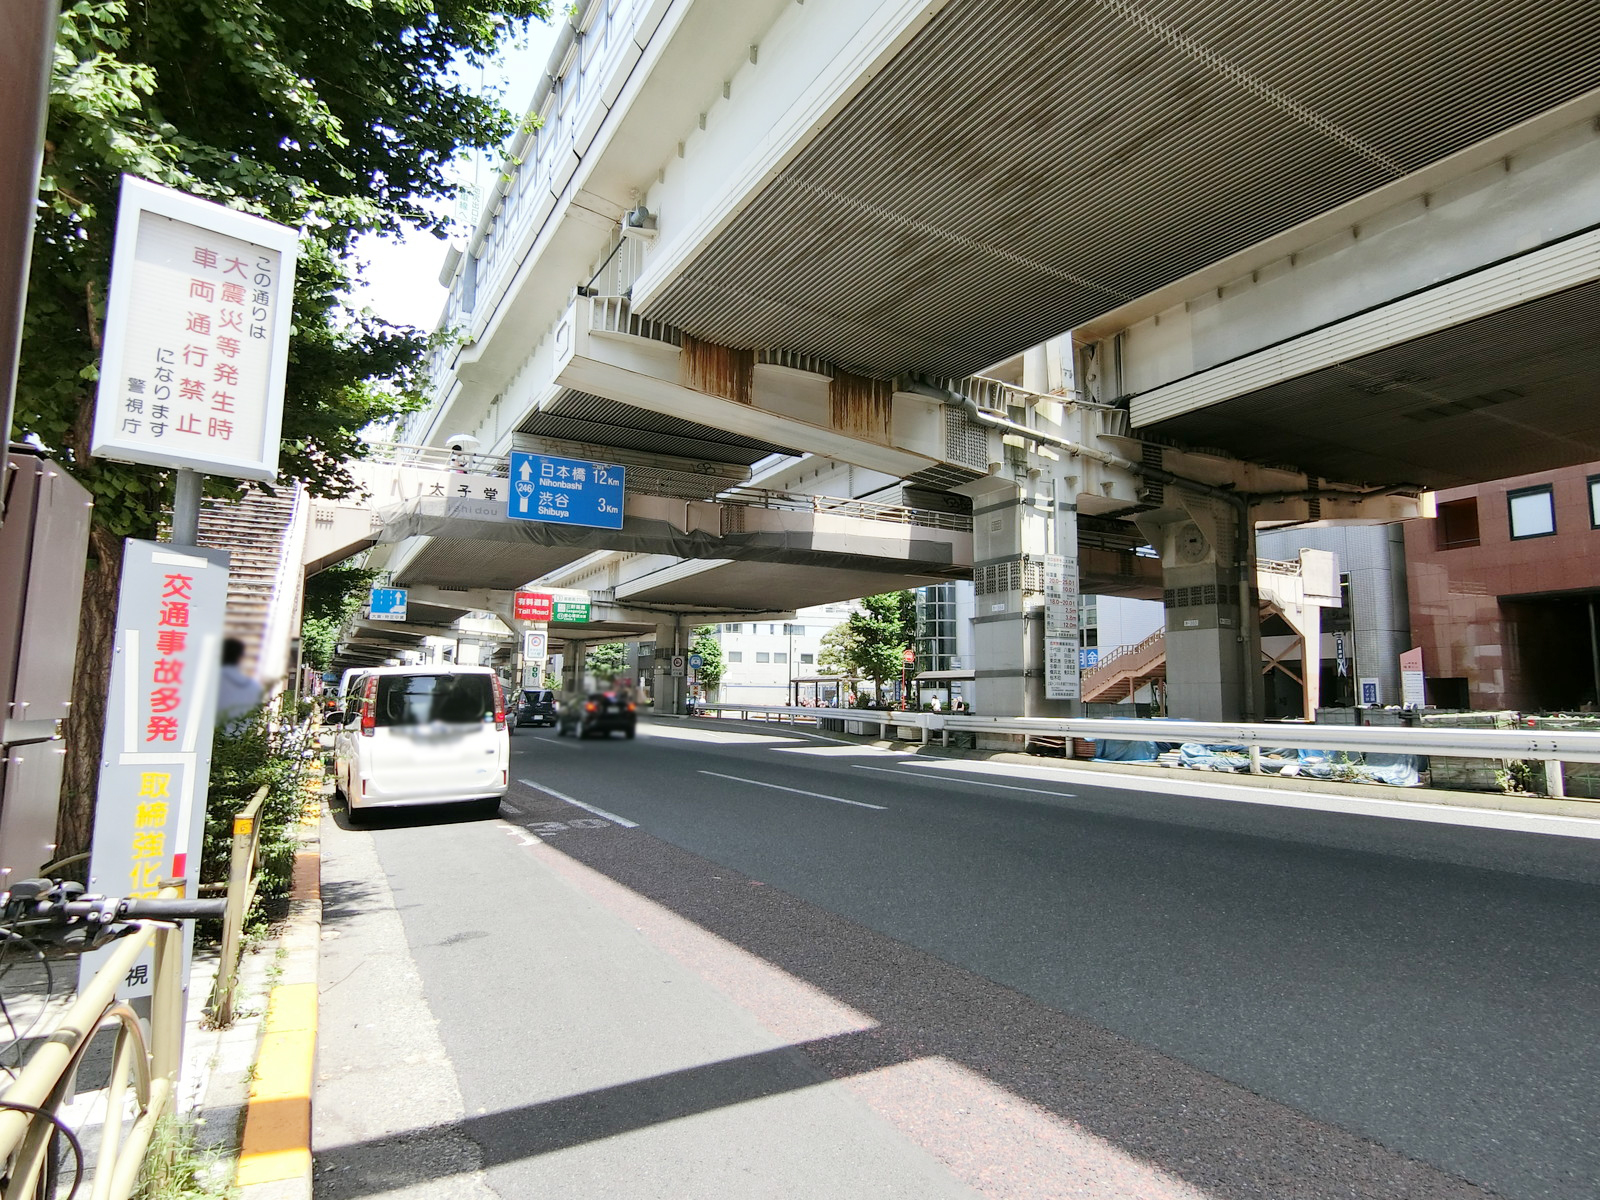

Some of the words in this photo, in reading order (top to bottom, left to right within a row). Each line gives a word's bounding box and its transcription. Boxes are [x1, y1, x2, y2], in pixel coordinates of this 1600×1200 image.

[249, 255, 272, 340] この通りは
[175, 246, 219, 436] 車両通行禁止
[207, 256, 249, 441] 大震災等発生時
[122, 376, 147, 435] 警視庁
[150, 347, 175, 438] になります
[429, 482, 498, 501] 太子堂
[518, 483, 532, 493] 246
[539, 477, 583, 491] Nihonbashi
[541, 463, 586, 482] 日本橋
[537, 506, 570, 518] Shibuya
[538, 491, 569, 508] 渋谷
[145, 573, 194, 742] 交通事故多発
